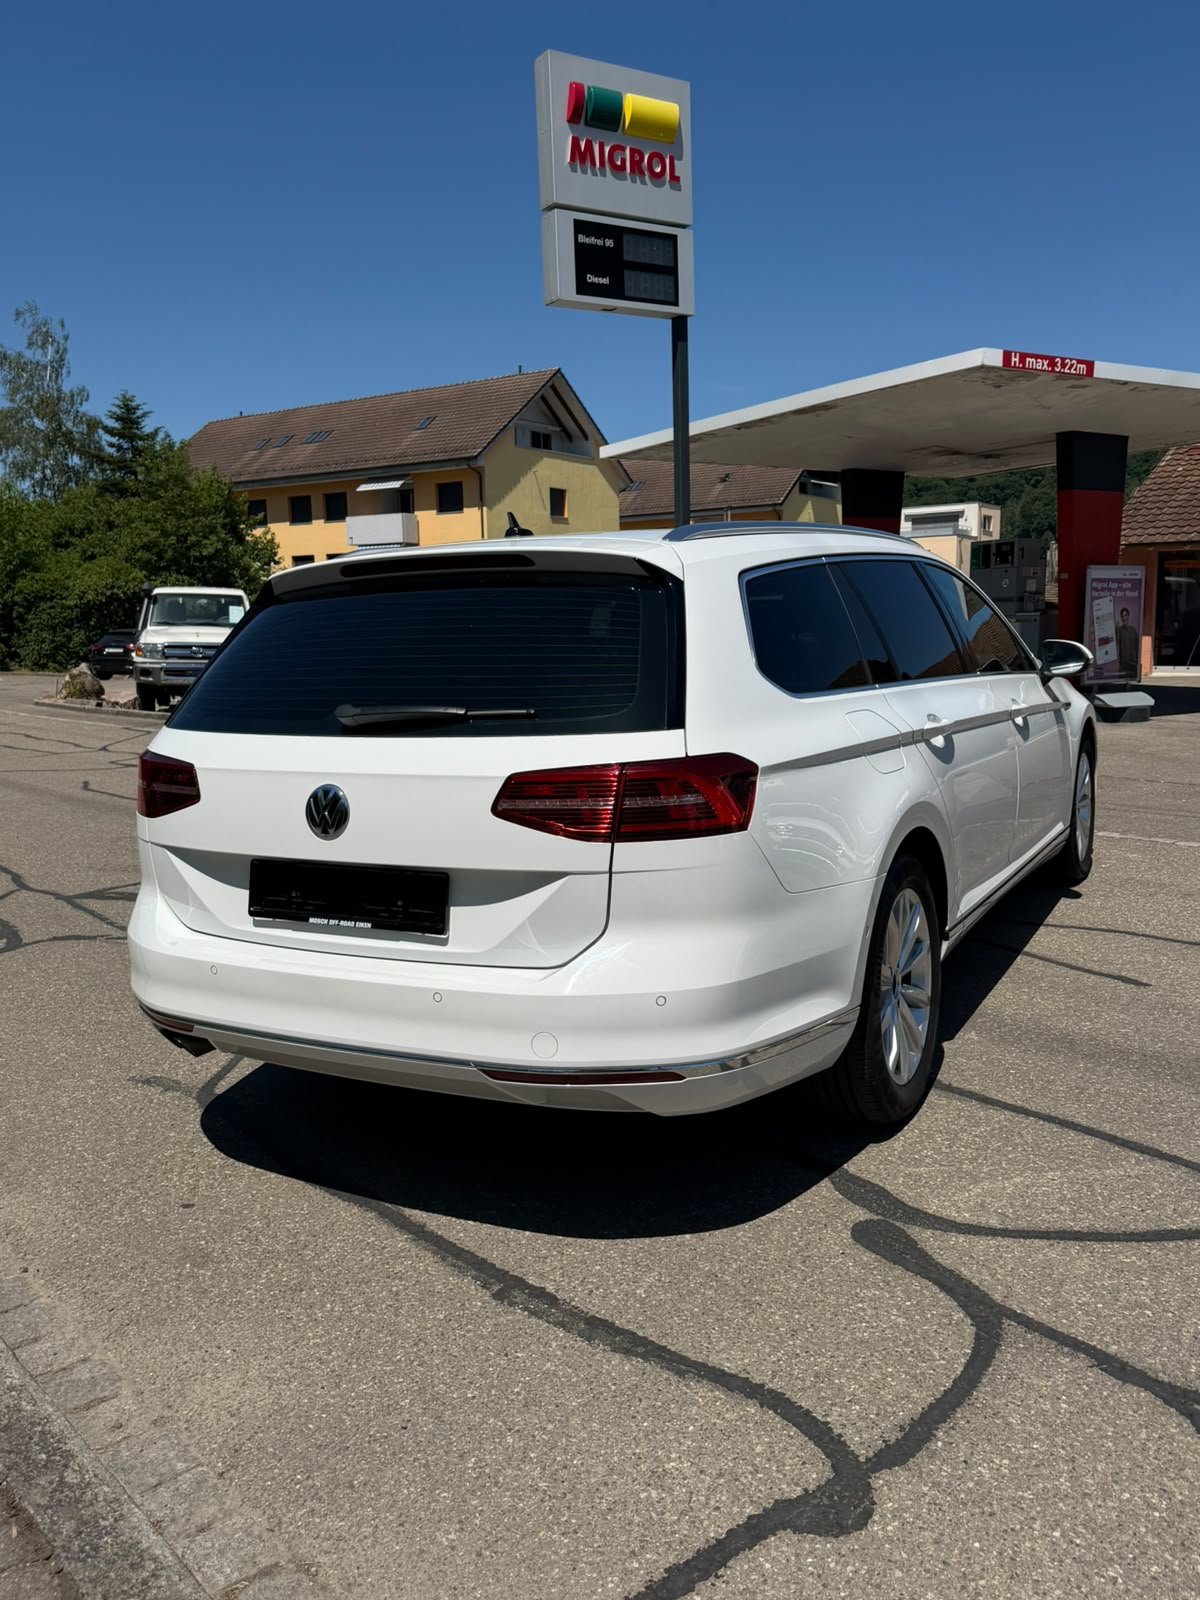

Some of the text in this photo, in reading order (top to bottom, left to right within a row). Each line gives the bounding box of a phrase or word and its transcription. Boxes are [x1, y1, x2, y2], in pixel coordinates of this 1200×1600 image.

[568, 135, 681, 184] MIGROL
[578, 233, 614, 248] Bleifrei 95
[586, 273, 610, 285] Diesel
[1011, 352, 1087, 375] H. max. 3.22m
